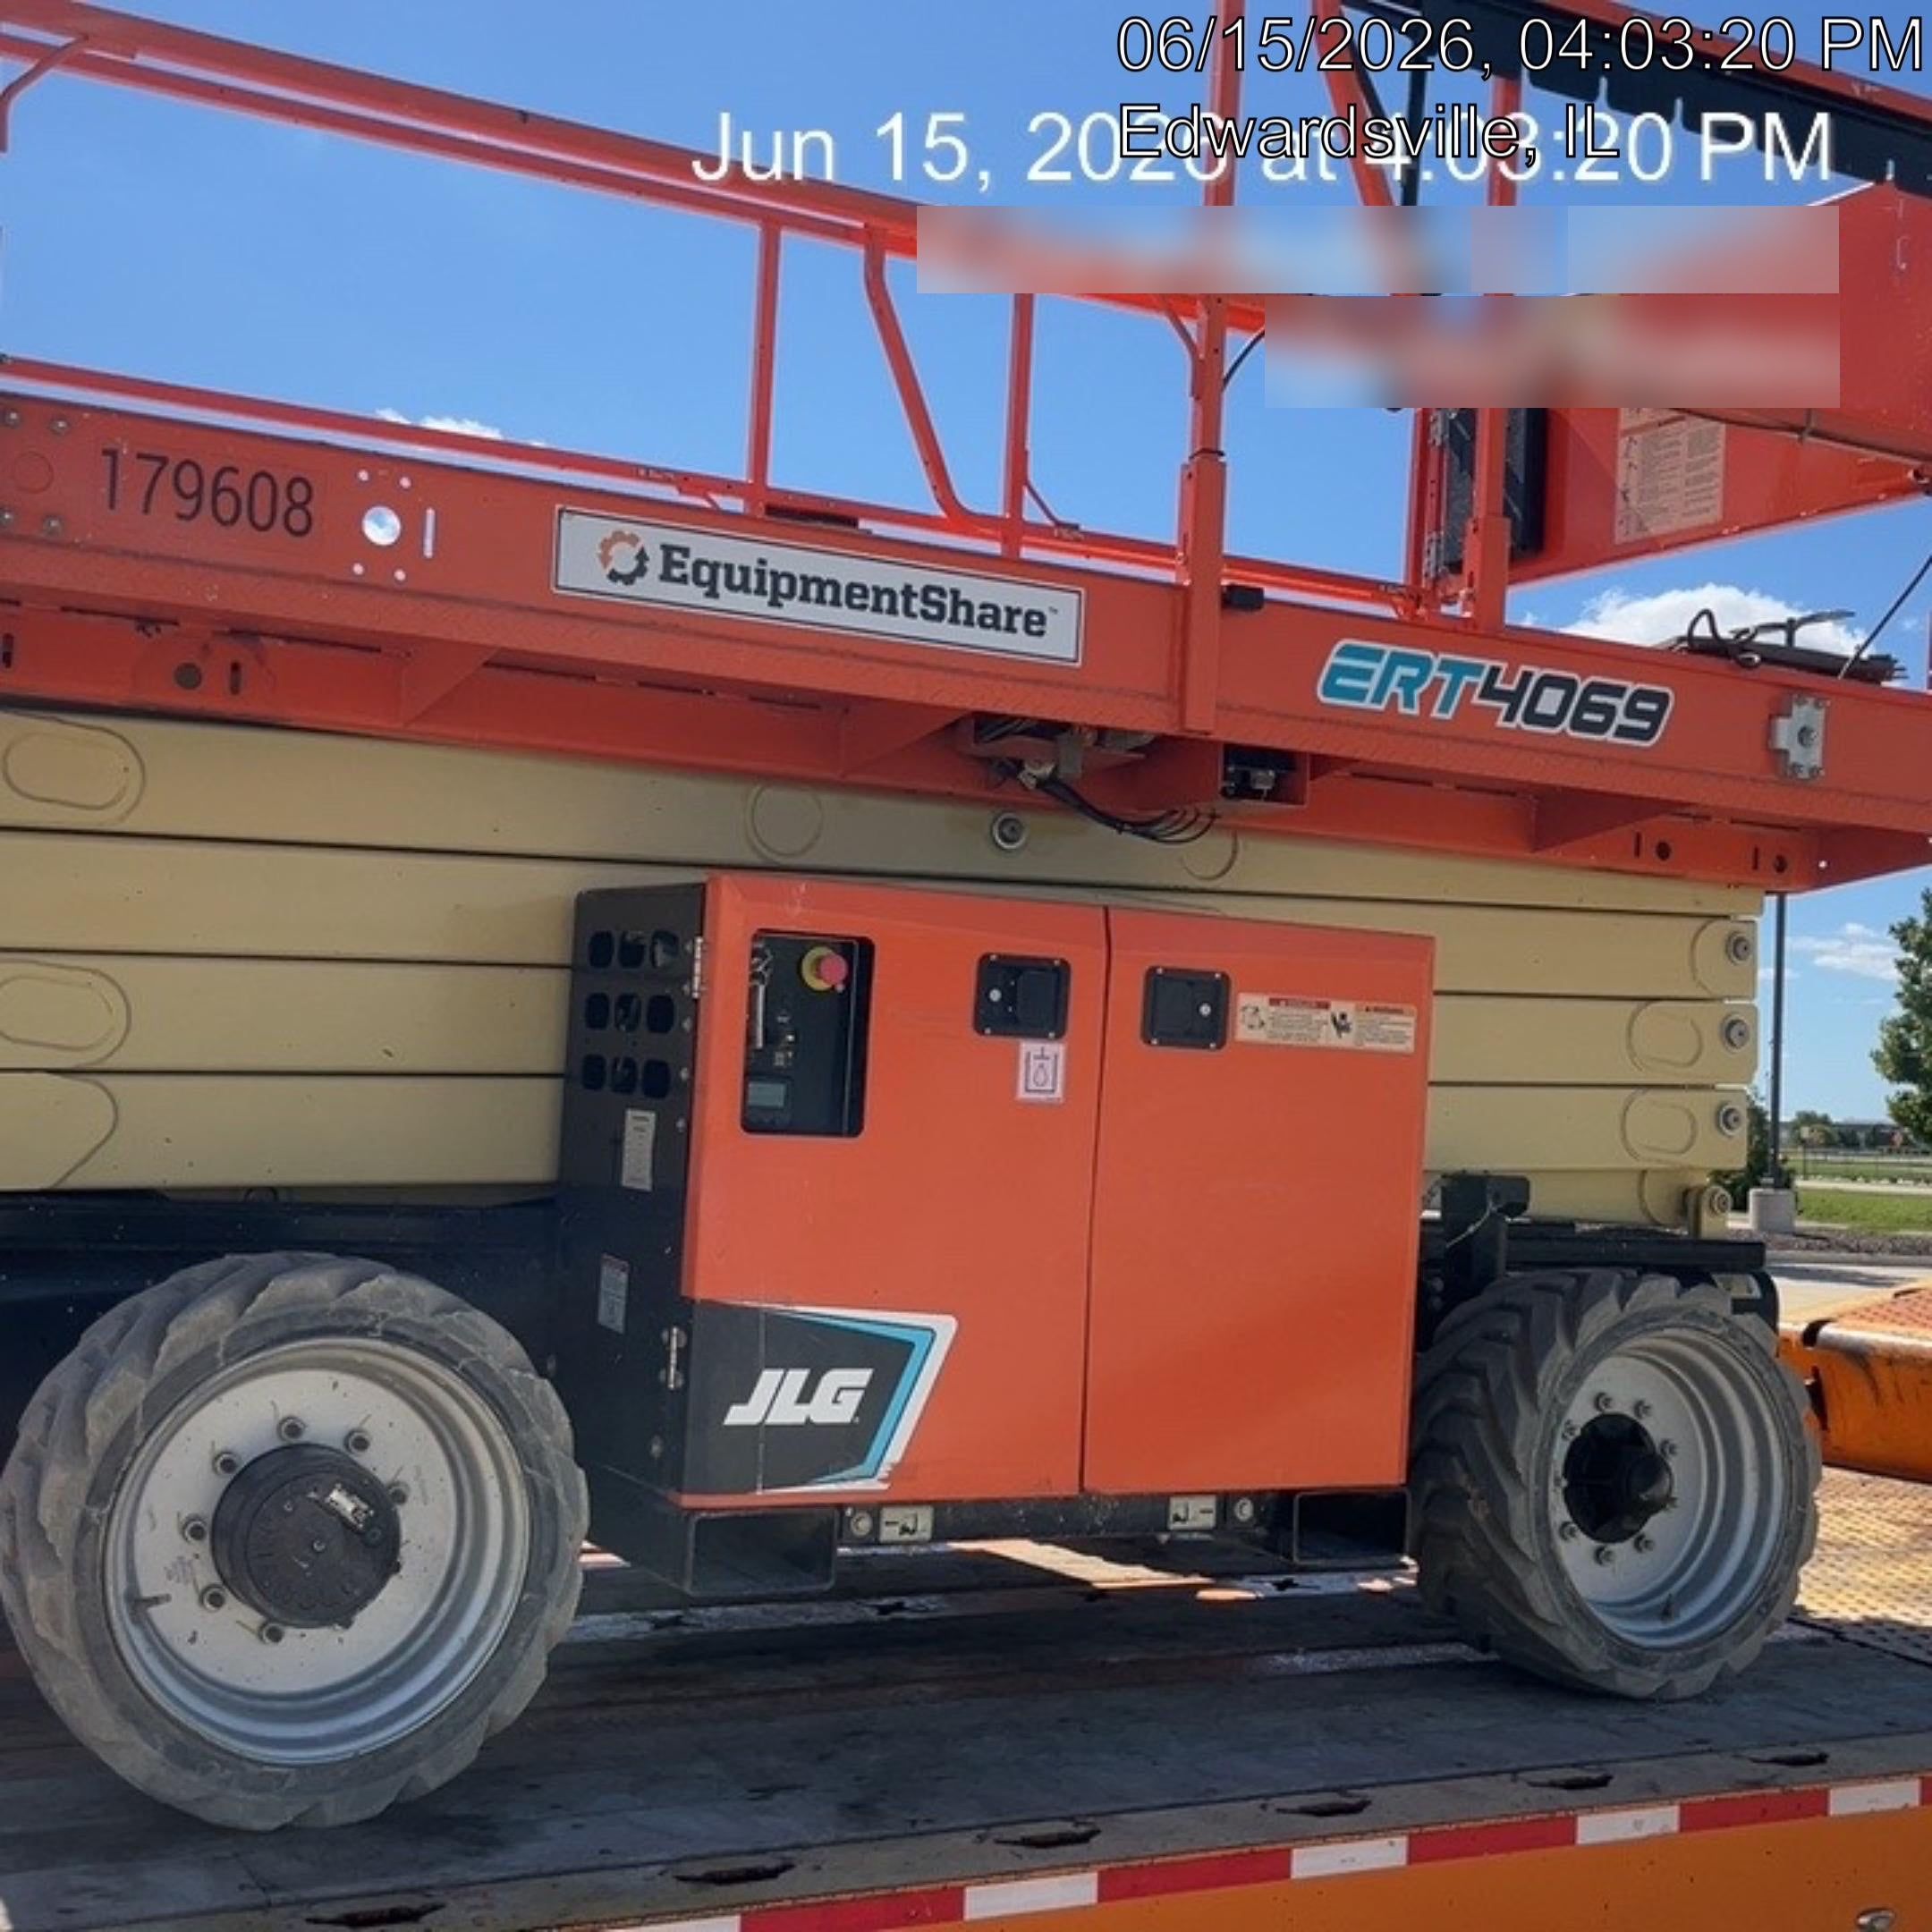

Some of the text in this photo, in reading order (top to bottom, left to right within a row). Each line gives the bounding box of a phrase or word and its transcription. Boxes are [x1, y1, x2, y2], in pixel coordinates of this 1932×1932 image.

[101, 448, 314, 538] 179608
[658, 542, 1047, 638] EquipmentShare
[1319, 641, 1671, 743] ERT4069
[723, 1368, 875, 1425] JLG
